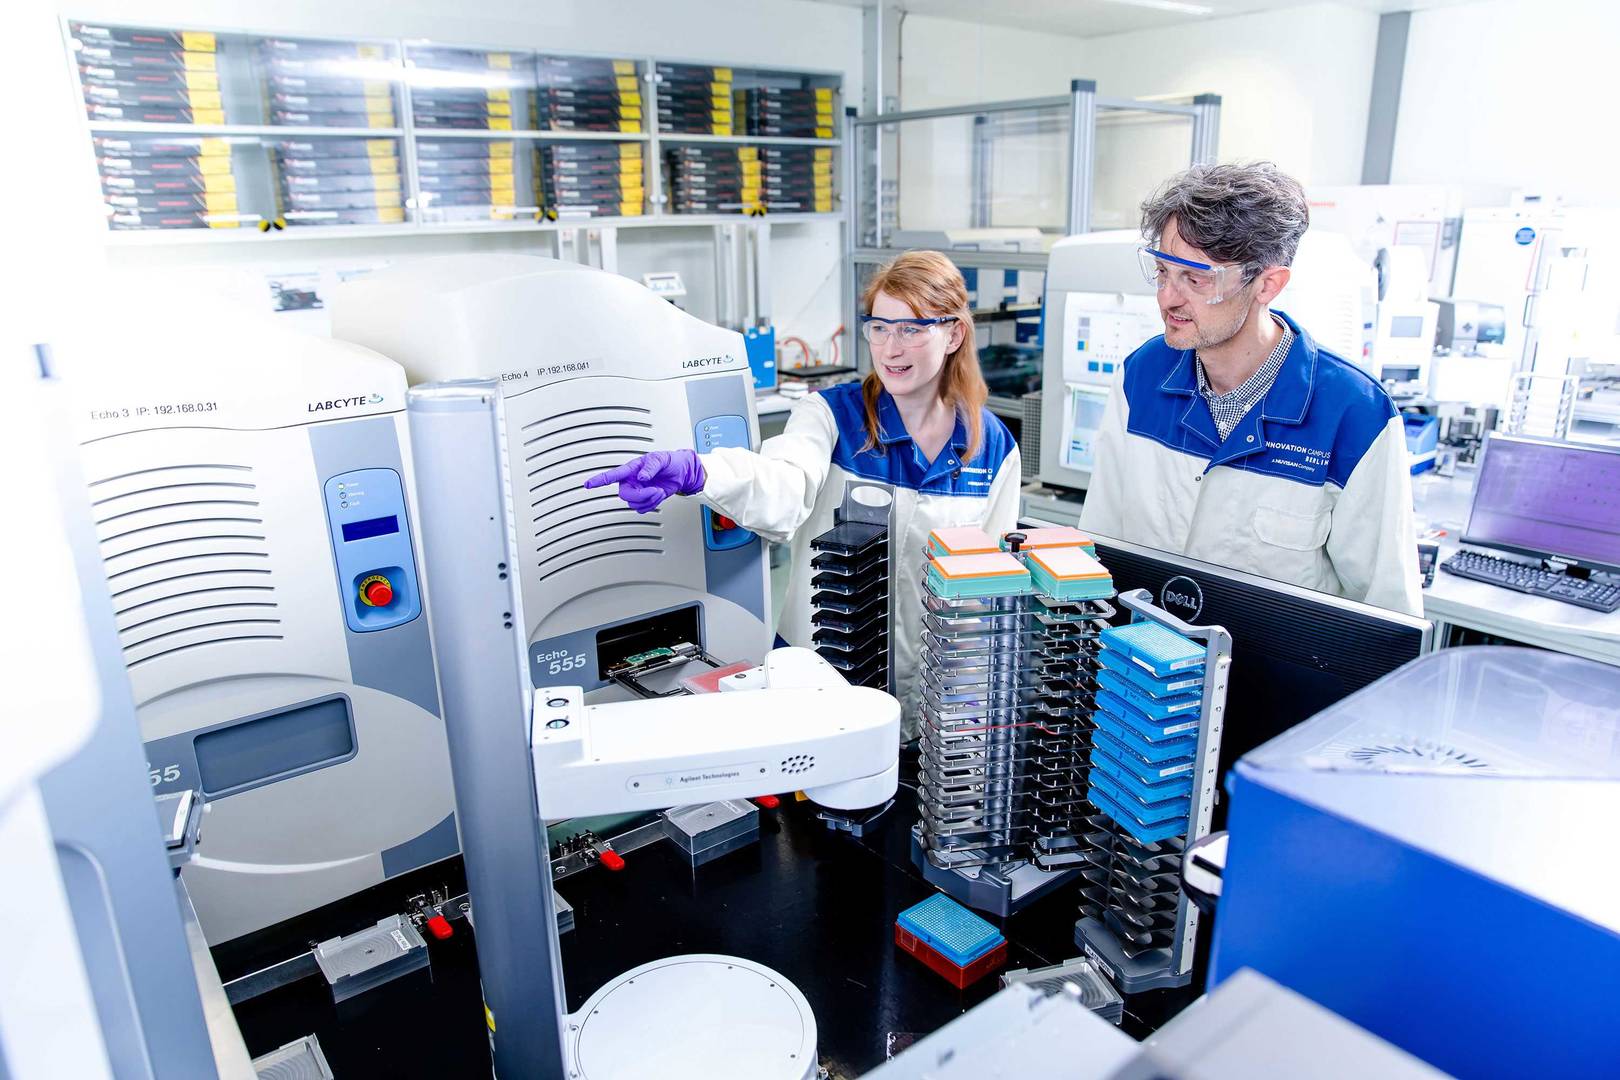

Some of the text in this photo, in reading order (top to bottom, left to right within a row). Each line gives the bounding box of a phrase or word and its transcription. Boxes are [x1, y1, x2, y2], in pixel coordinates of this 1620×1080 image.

[682, 357, 722, 369] LABCYTE
[501, 371, 522, 382] Echo
[523, 370, 529, 378] 4
[90, 402, 218, 420] Echo 3 IP: 192.168.0.31
[307, 395, 366, 412] LABCYTE
[1265, 440, 1332, 459] NNOVATION CAMPUS
[1305, 456, 1330, 466] BERLIN
[1165, 590, 1197, 610] DELL
[536, 649, 568, 664] Echo
[548, 653, 587, 675] 555
[149, 764, 181, 786] 55
[679, 770, 740, 784] Agilent Technologies
